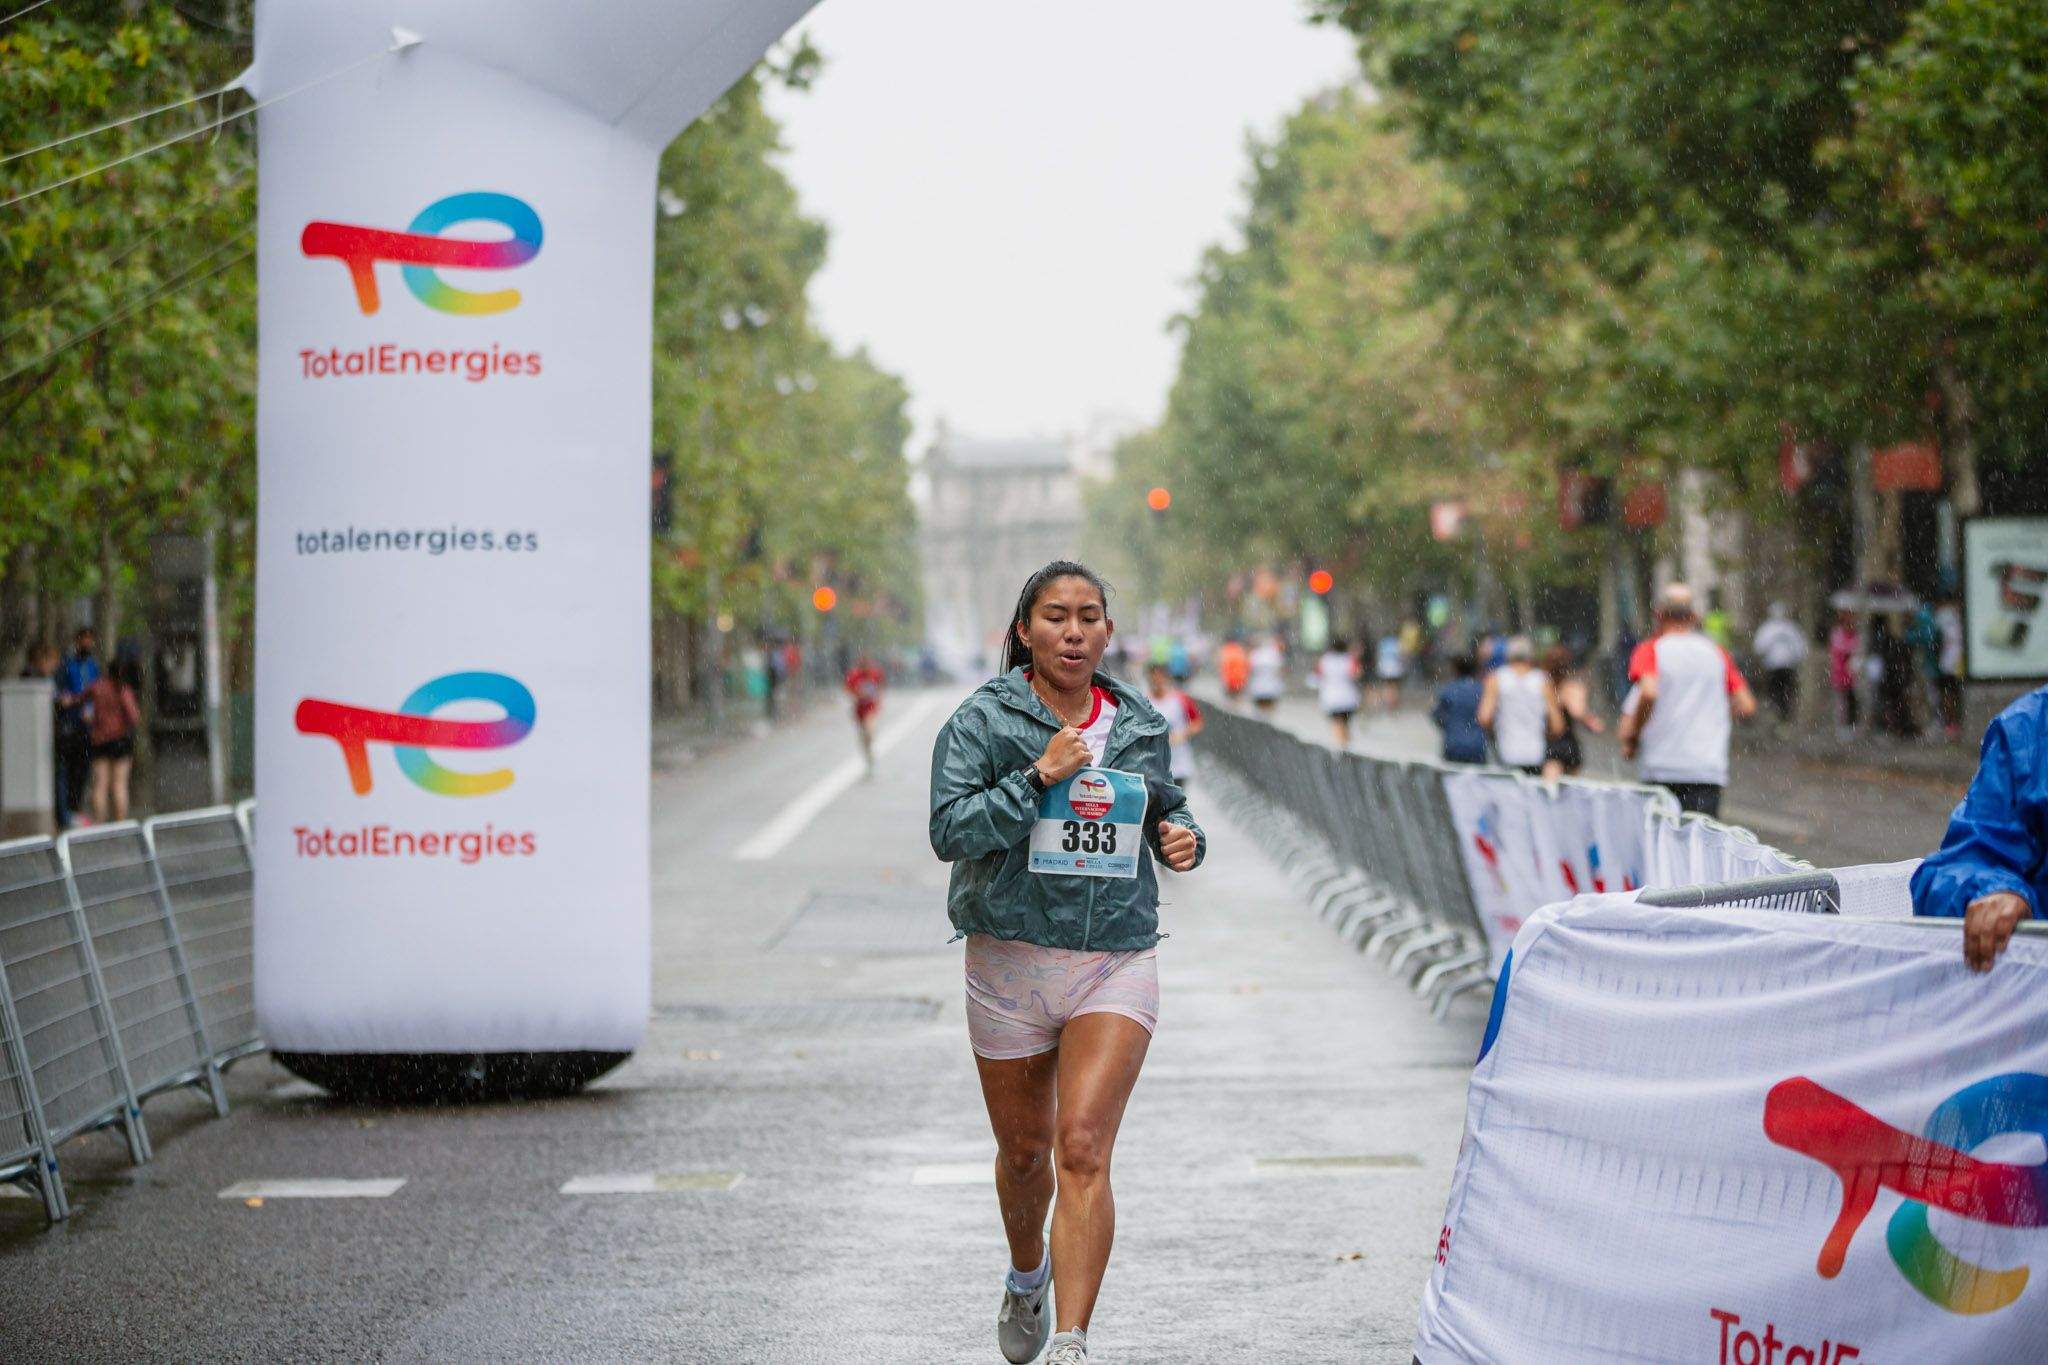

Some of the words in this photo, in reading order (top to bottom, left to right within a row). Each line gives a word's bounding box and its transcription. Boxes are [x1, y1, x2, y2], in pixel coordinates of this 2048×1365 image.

[299, 343, 543, 382] TotalEnergies
[297, 526, 538, 555] totalenergies.es
[294, 823, 536, 863] TotalEnergies
[1062, 820, 1117, 854] 333
